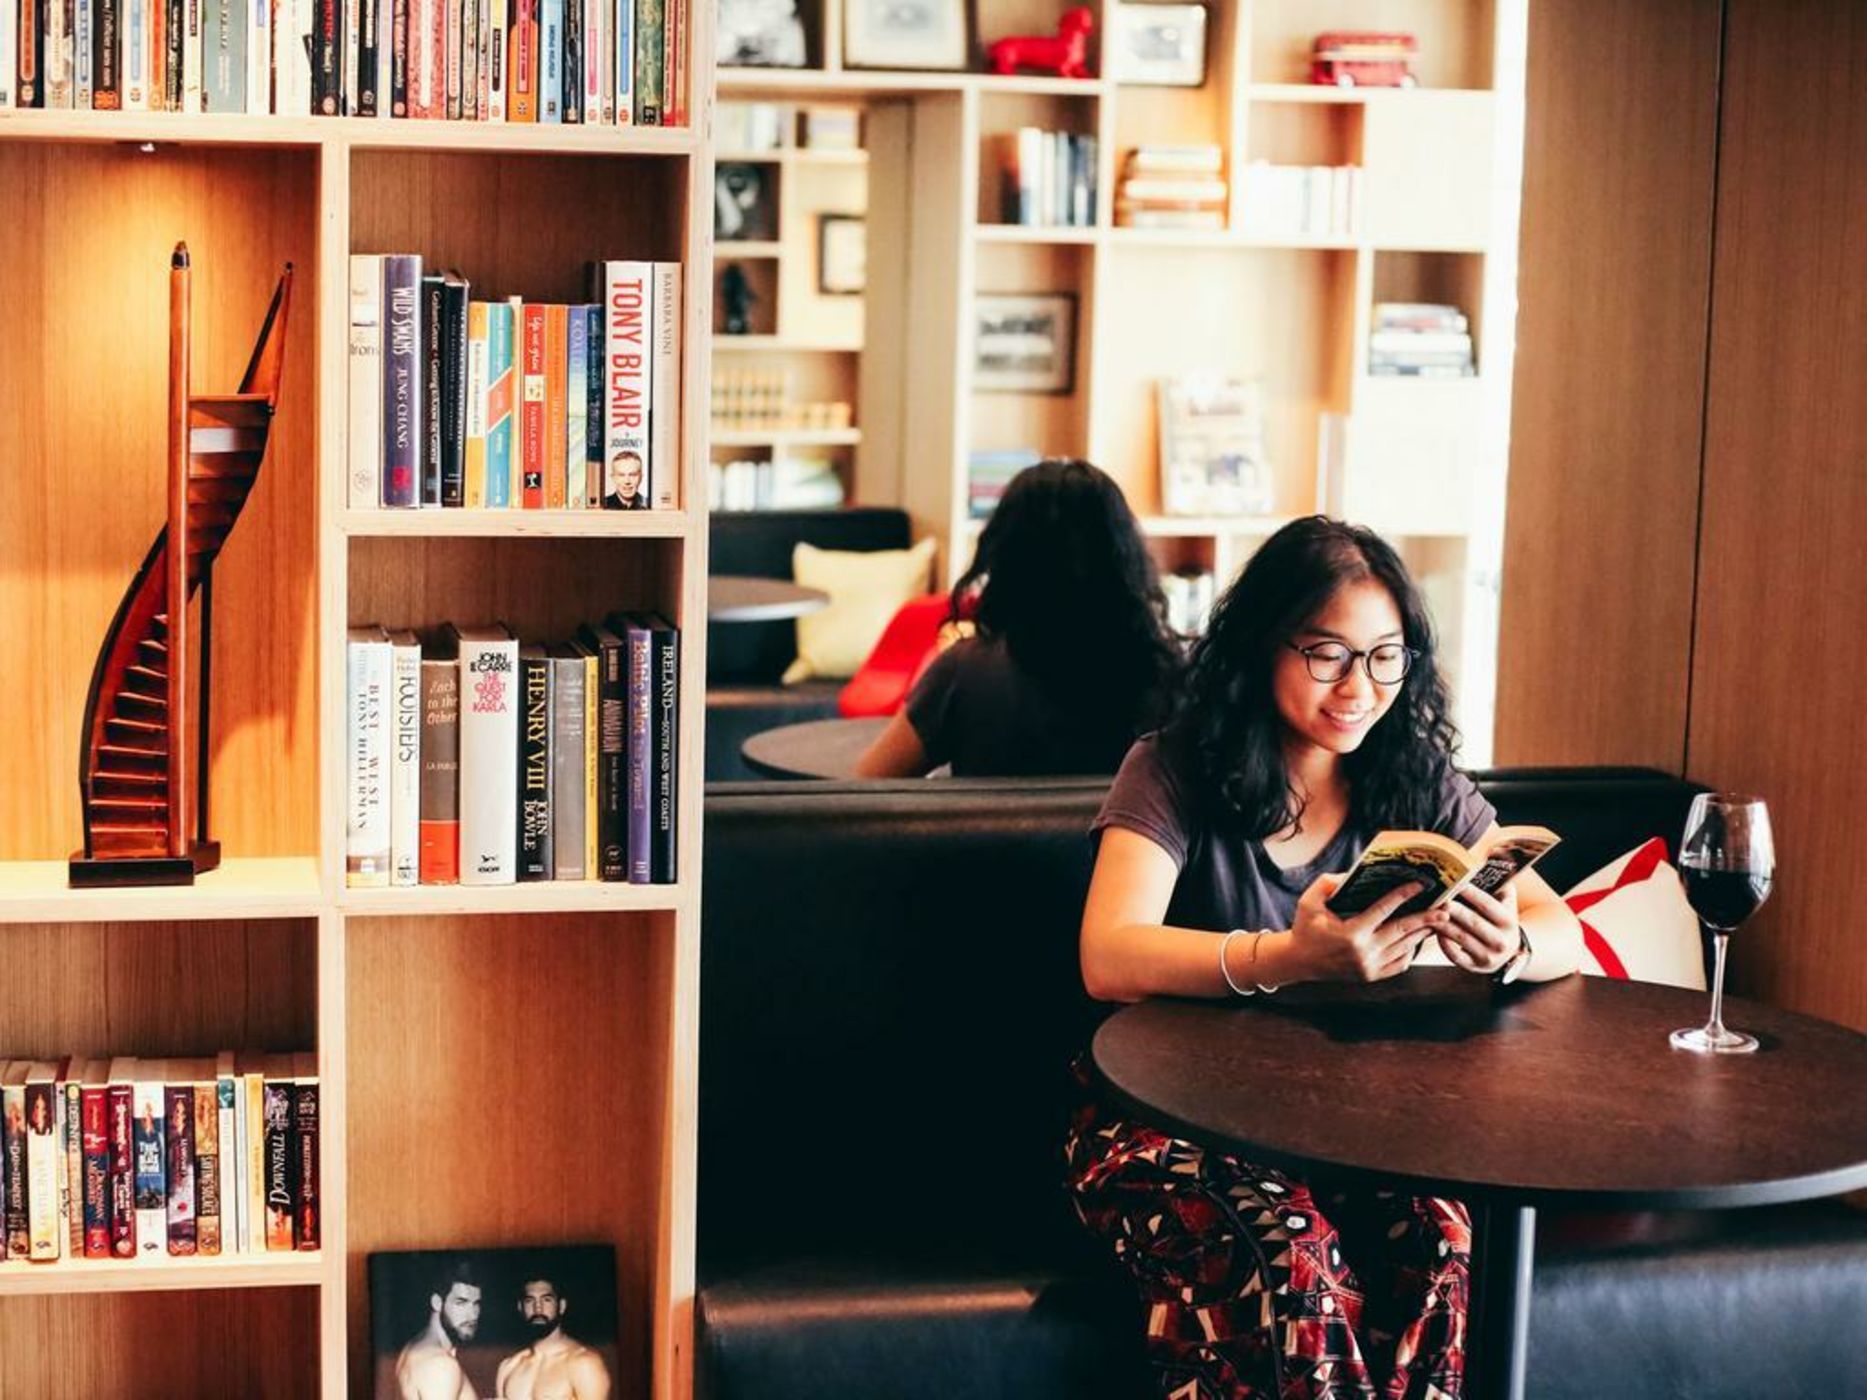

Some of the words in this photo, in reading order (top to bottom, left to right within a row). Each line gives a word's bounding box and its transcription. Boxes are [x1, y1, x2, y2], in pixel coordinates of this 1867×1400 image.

[391, 287, 414, 314] WILD
[611, 279, 643, 345] TONY
[663, 273, 672, 324] BARBARA
[391, 319, 414, 355] SWANS
[396, 367, 410, 400] JUNG
[611, 354, 642, 428] BLAIR
[396, 404, 409, 448] CHANG
[480, 652, 507, 662] JOHN
[633, 641, 649, 689] Baltic
[357, 693, 368, 731] TONY
[399, 677, 418, 762] FOOTSTEPS
[473, 702, 508, 713] KARLA
[526, 667, 546, 746] HENRY
[633, 694, 649, 736] Pilot
[525, 749, 545, 790] VIII
[661, 773, 669, 796] WEST
[523, 800, 537, 850] BOWLE
[536, 800, 548, 835] JOHN
